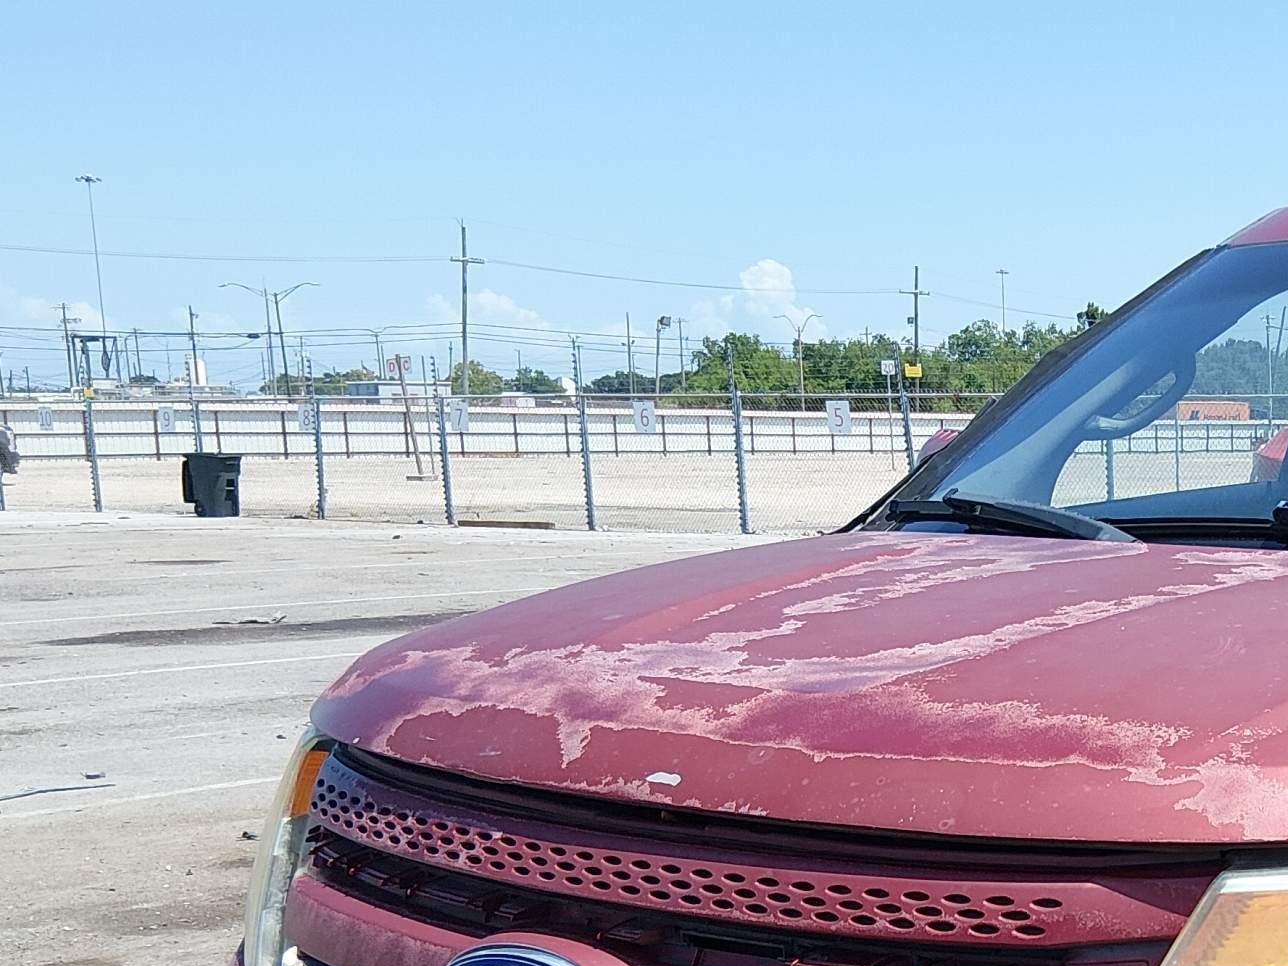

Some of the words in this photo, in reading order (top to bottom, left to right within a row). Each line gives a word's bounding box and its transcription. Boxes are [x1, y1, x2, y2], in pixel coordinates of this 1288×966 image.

[389, 362, 396, 372] D
[40, 410, 52, 427] 10
[163, 411, 171, 427] 9
[303, 409, 310, 426] 8
[455, 408, 463, 427] 7
[640, 408, 650, 427] 6
[834, 407, 844, 427] 5
